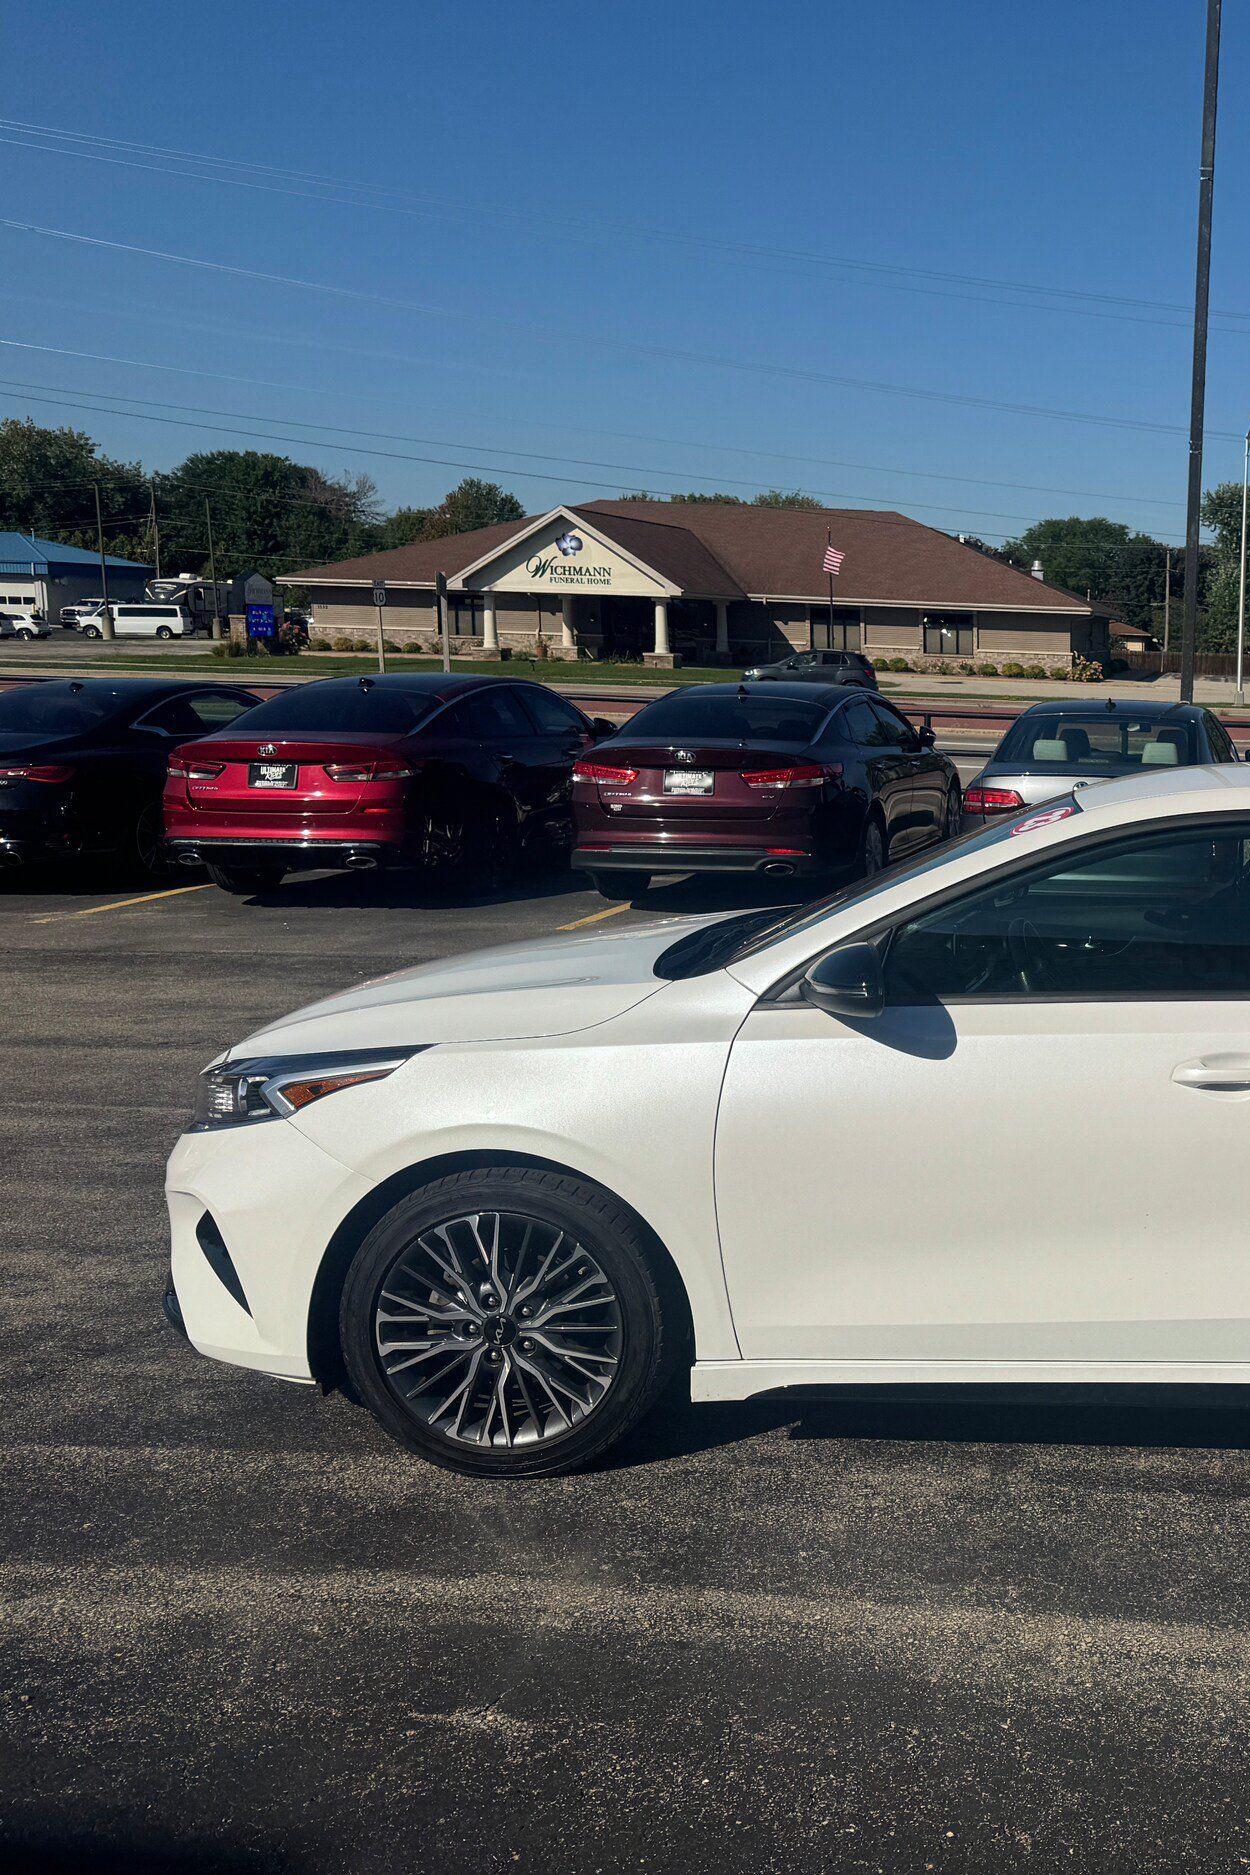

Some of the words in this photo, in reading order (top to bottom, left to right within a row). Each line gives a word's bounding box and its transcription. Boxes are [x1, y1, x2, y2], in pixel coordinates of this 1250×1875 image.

[526, 555, 612, 578] WICHMANN
[549, 576, 586, 584] FUNERAL
[375, 592, 385, 603] 10
[260, 746, 275, 754] KIA
[677, 752, 693, 760] KIA
